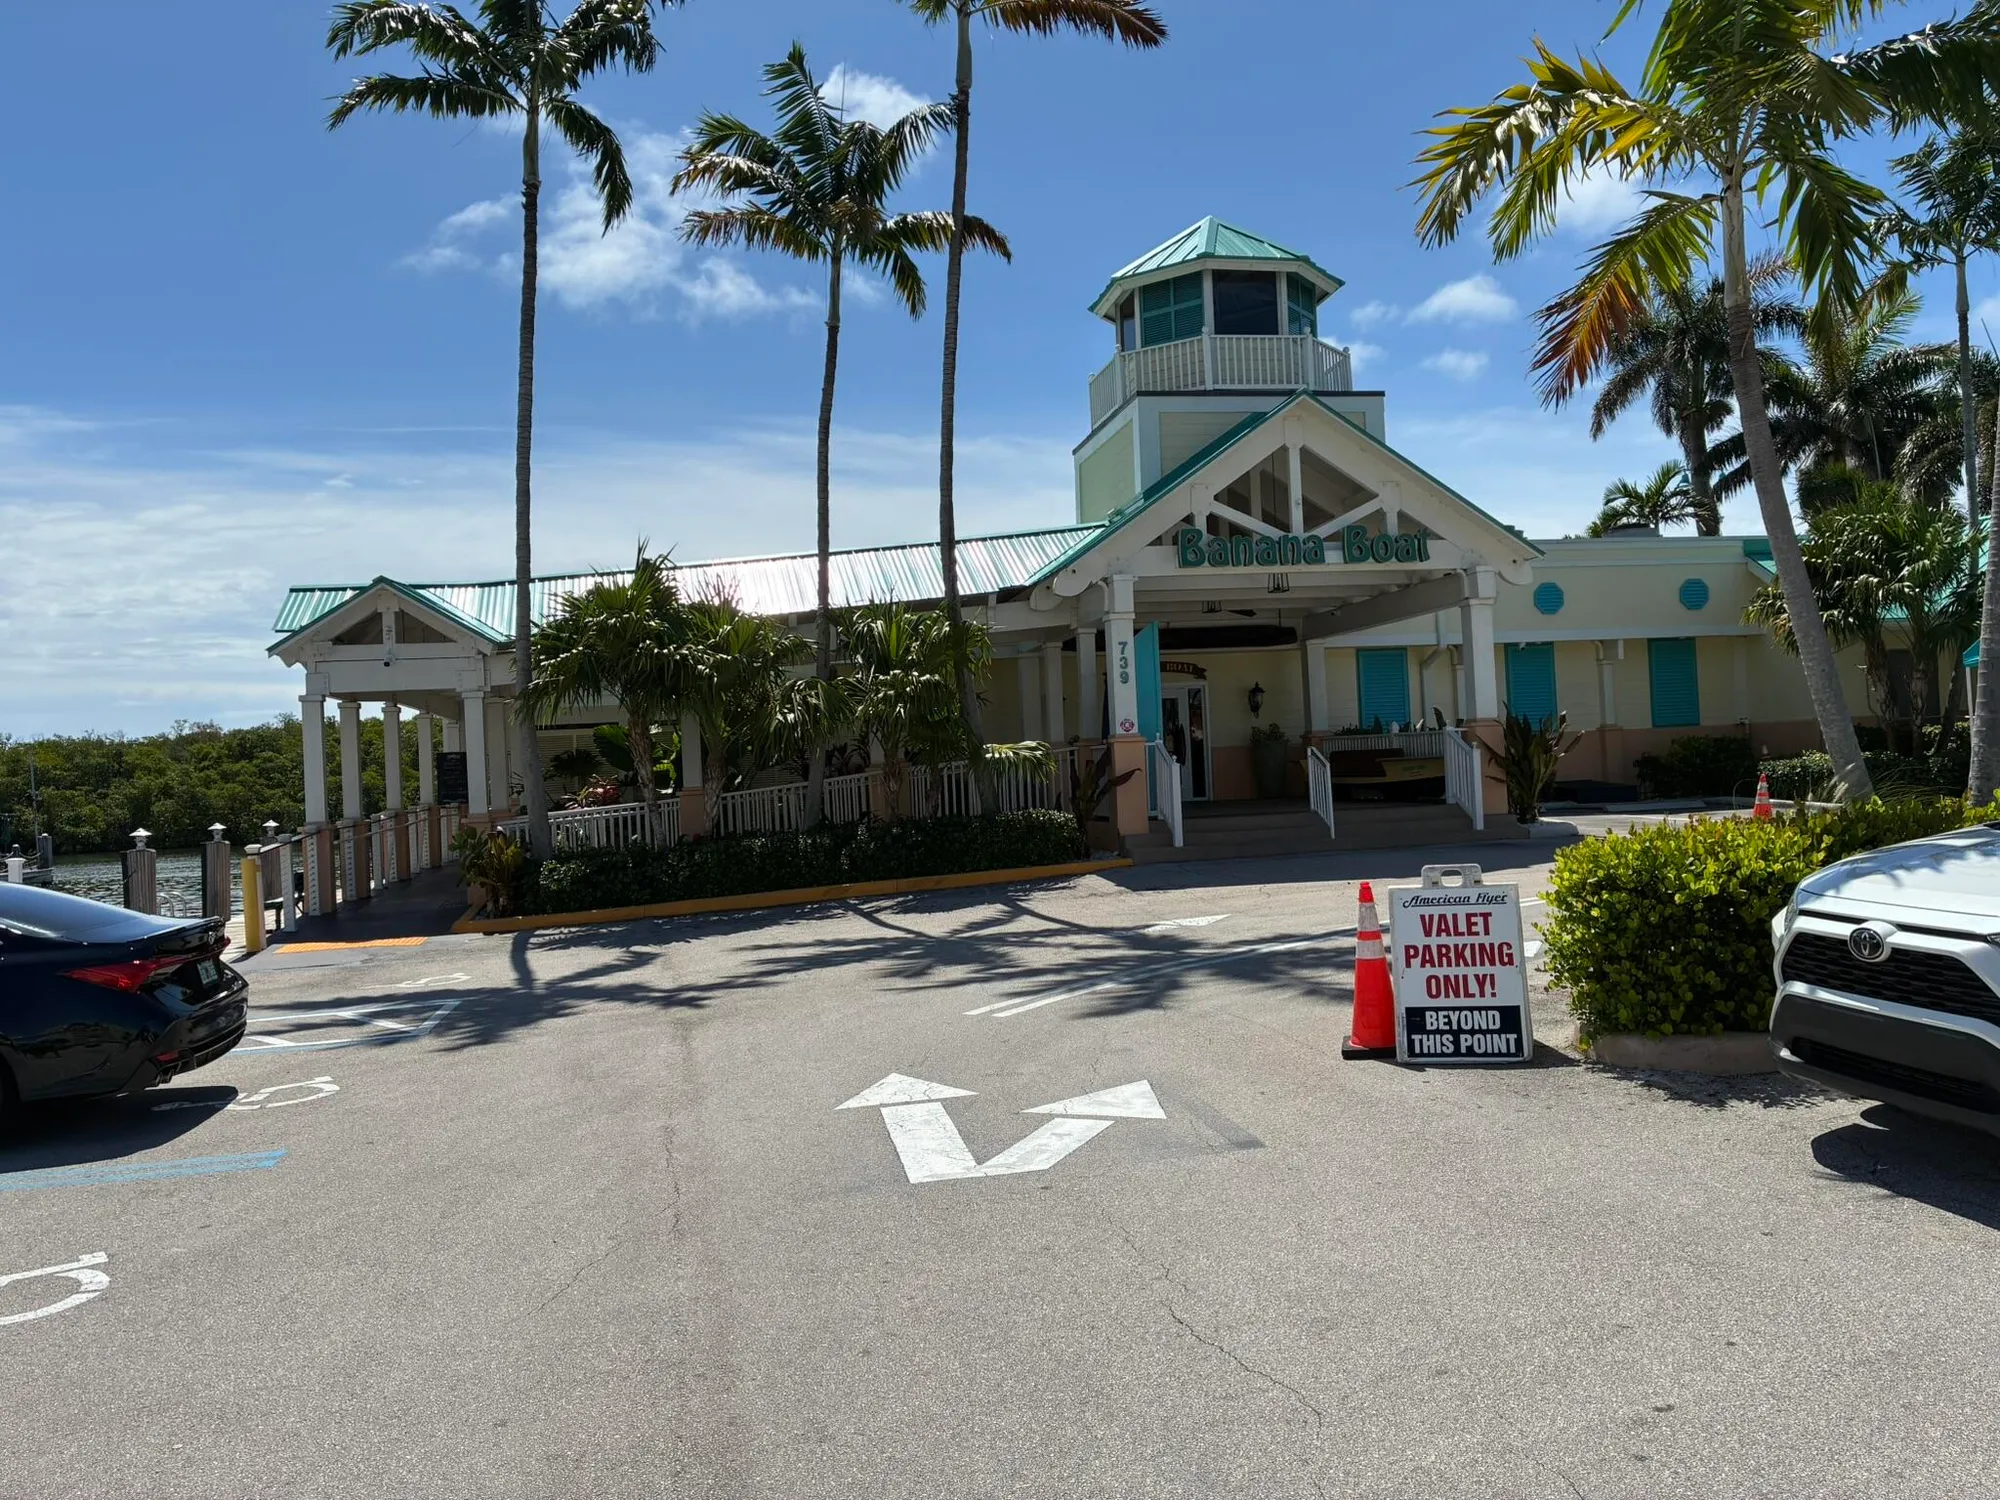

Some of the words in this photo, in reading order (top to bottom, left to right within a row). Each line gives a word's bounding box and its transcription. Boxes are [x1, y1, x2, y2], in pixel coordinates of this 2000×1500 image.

[1177, 528, 1326, 568] Banana
[1341, 524, 1431, 563] Boat
[1118, 641, 1129, 684] 739
[1402, 894, 1470, 908] American
[1475, 891, 1507, 905] Flyer
[1420, 912, 1492, 937] VALET
[1404, 942, 1514, 968] PARKING
[1426, 973, 1497, 998] ONLY!
[1425, 1010, 1500, 1030] BEYOND
[1411, 1034, 1454, 1053] THIS
[1460, 1033, 1517, 1054] POINT
